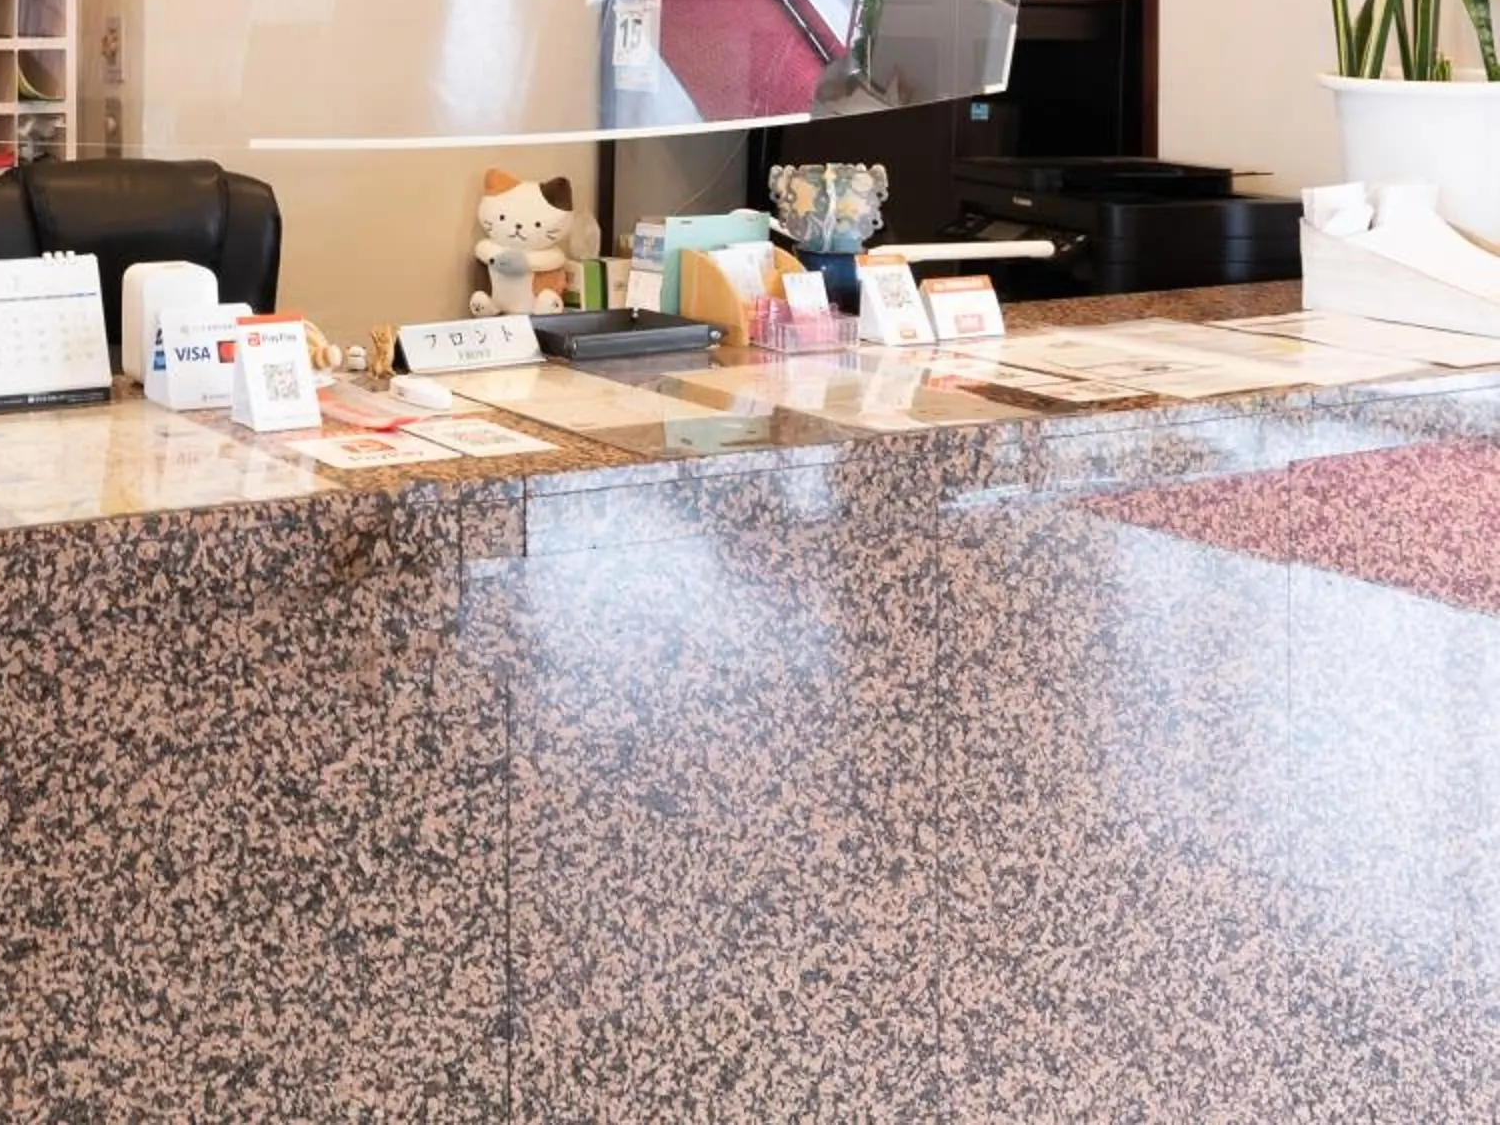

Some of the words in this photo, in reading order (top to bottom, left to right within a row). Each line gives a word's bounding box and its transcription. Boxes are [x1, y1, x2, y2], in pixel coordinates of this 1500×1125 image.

[262, 330, 298, 344] PayPay
[423, 324, 513, 349] フロント
[175, 346, 211, 362] VISA
